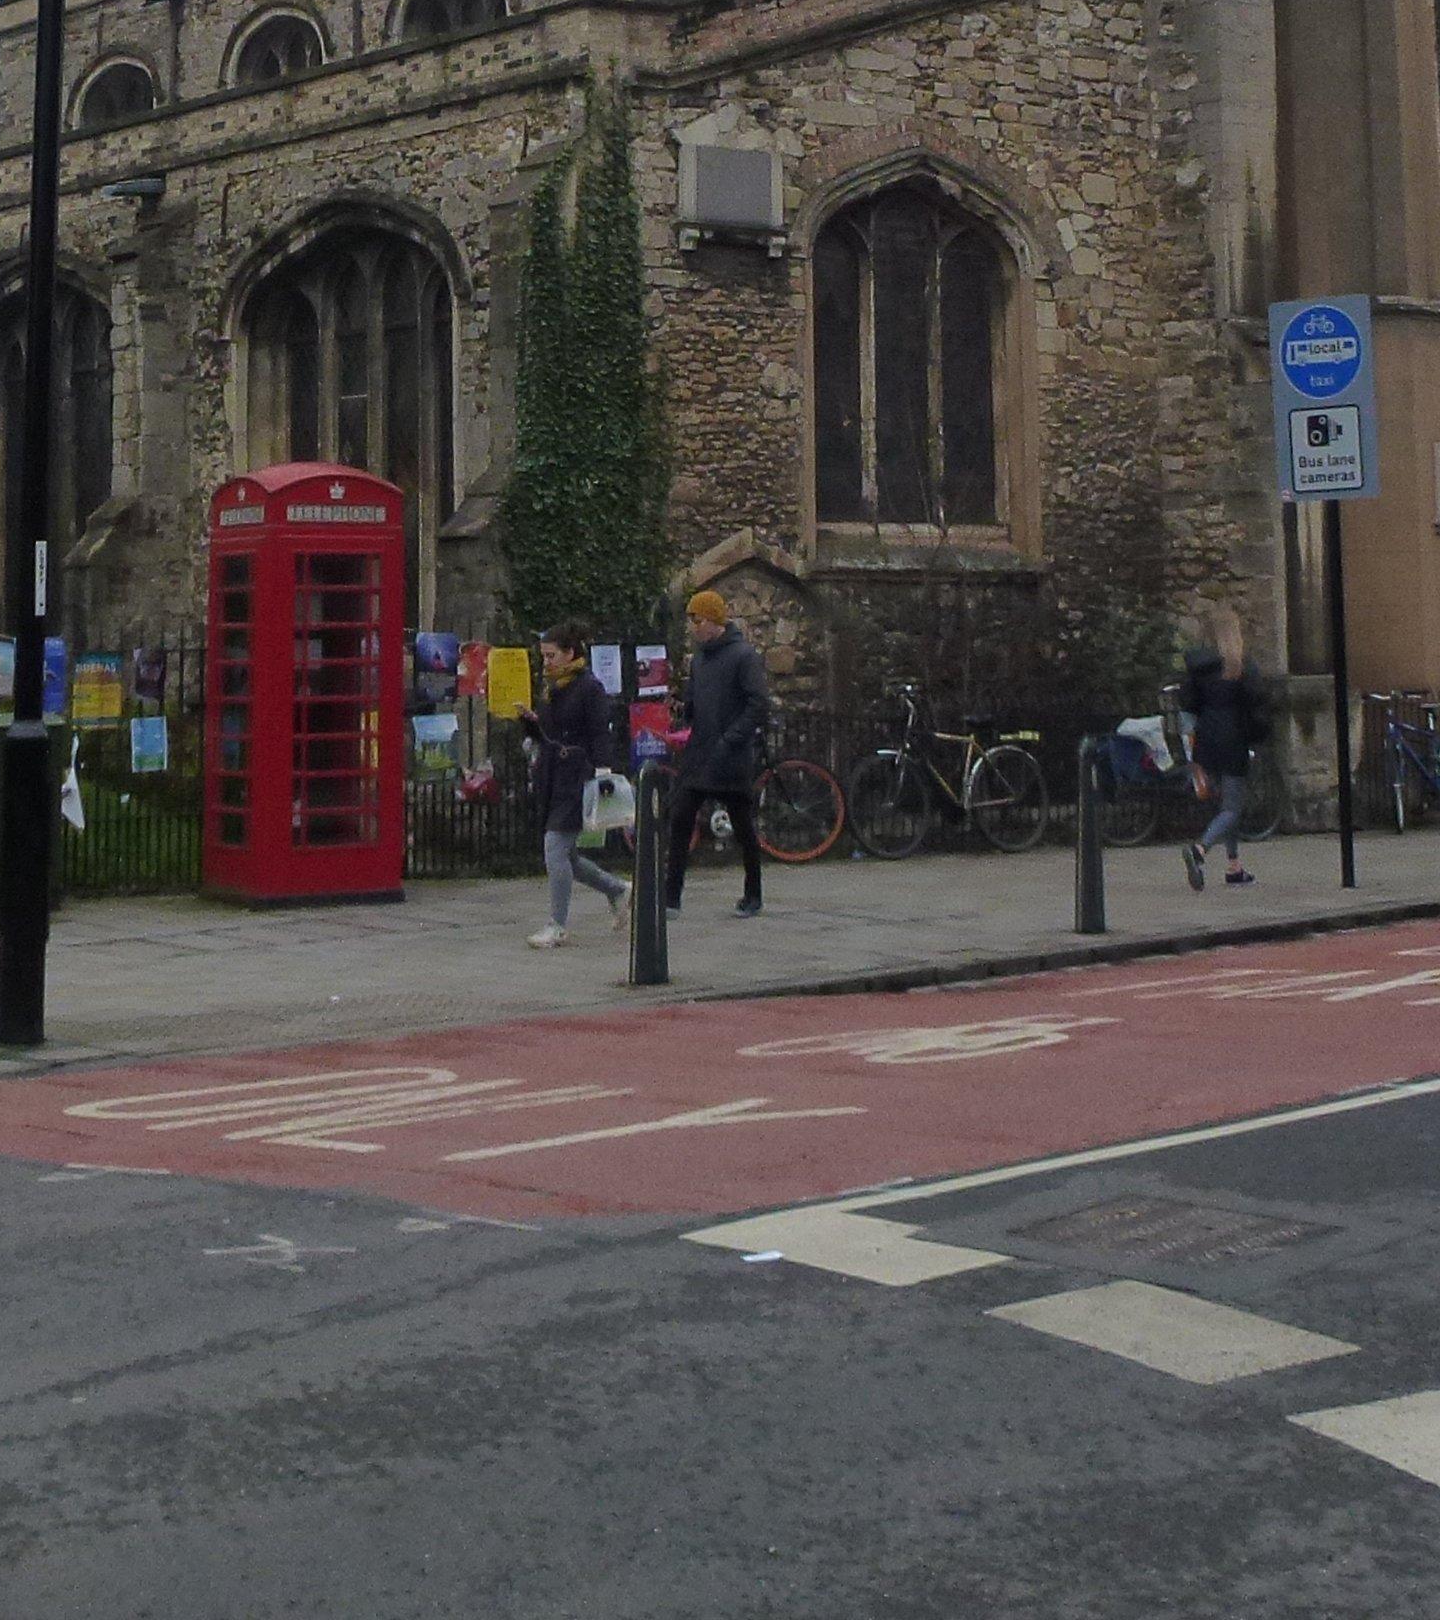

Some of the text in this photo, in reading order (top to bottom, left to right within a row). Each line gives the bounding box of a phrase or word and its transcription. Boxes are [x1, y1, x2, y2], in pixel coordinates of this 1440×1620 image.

[1309, 340, 1342, 355] local
[1310, 374, 1335, 387] taxi
[1298, 453, 1356, 469] Bus lane
[1299, 470, 1356, 485] cameras
